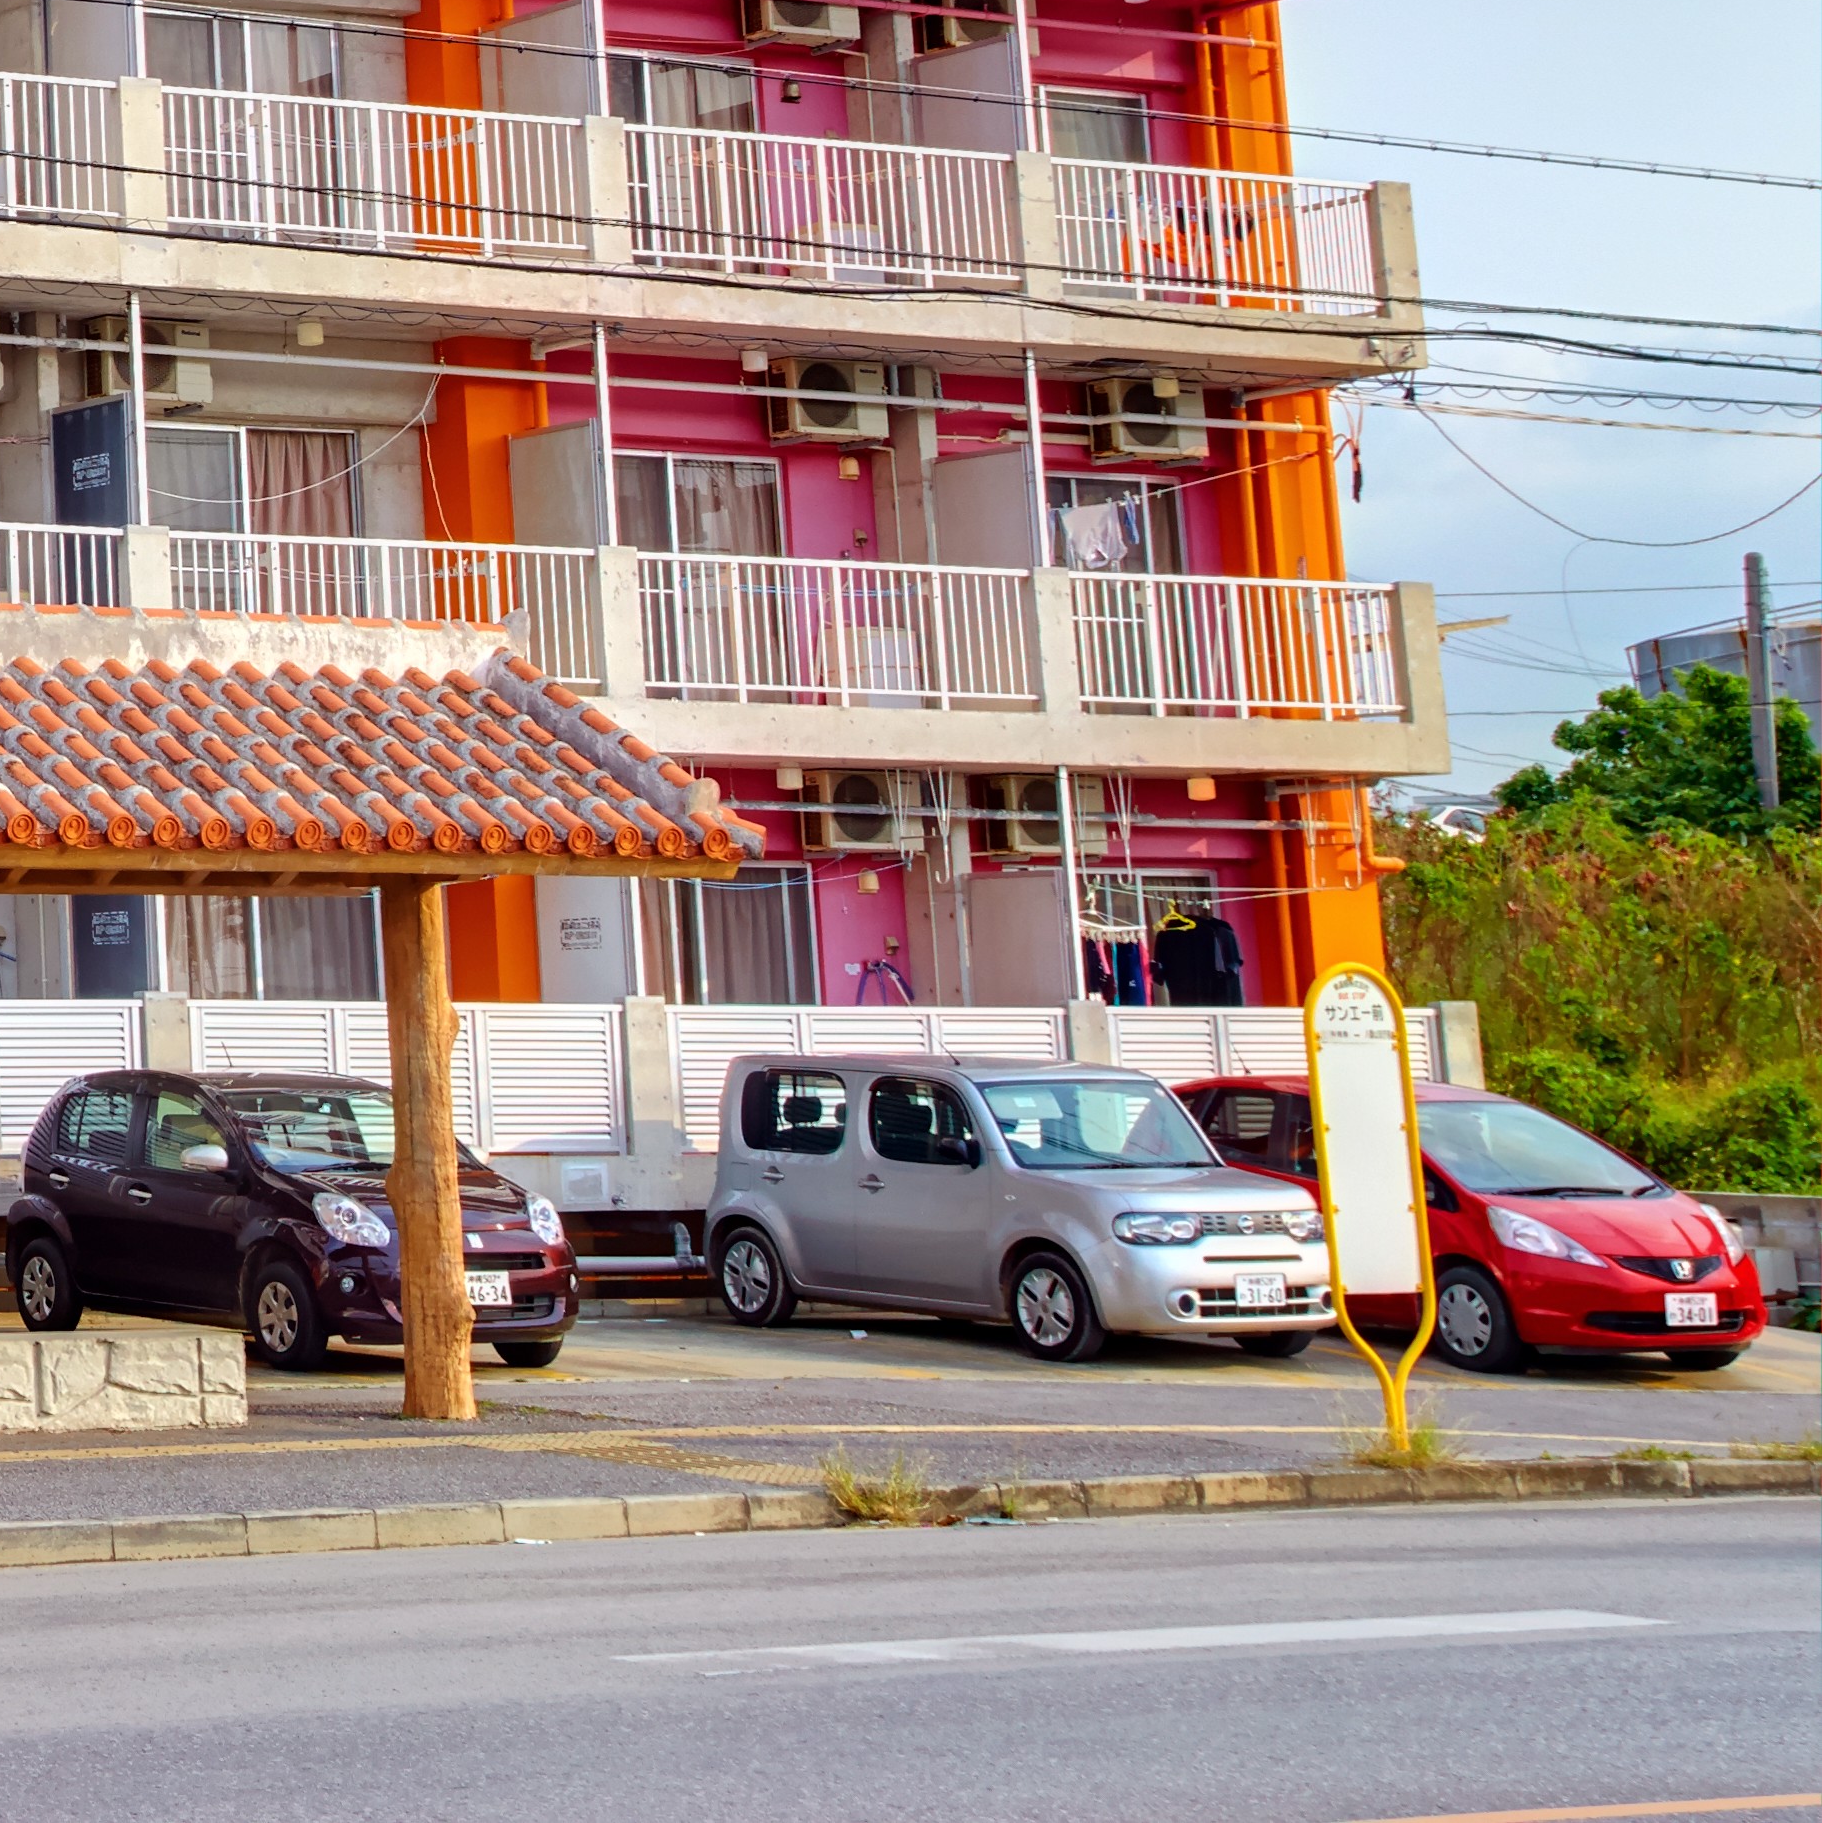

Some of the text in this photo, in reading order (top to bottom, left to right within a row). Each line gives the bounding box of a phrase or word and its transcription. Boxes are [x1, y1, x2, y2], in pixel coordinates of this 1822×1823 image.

[1324, 1004, 1384, 1022] サンエー前
[469, 1285, 508, 1303] 46-34
[1247, 1288, 1283, 1304] 31-60
[1677, 1307, 1713, 1323] 34-01
